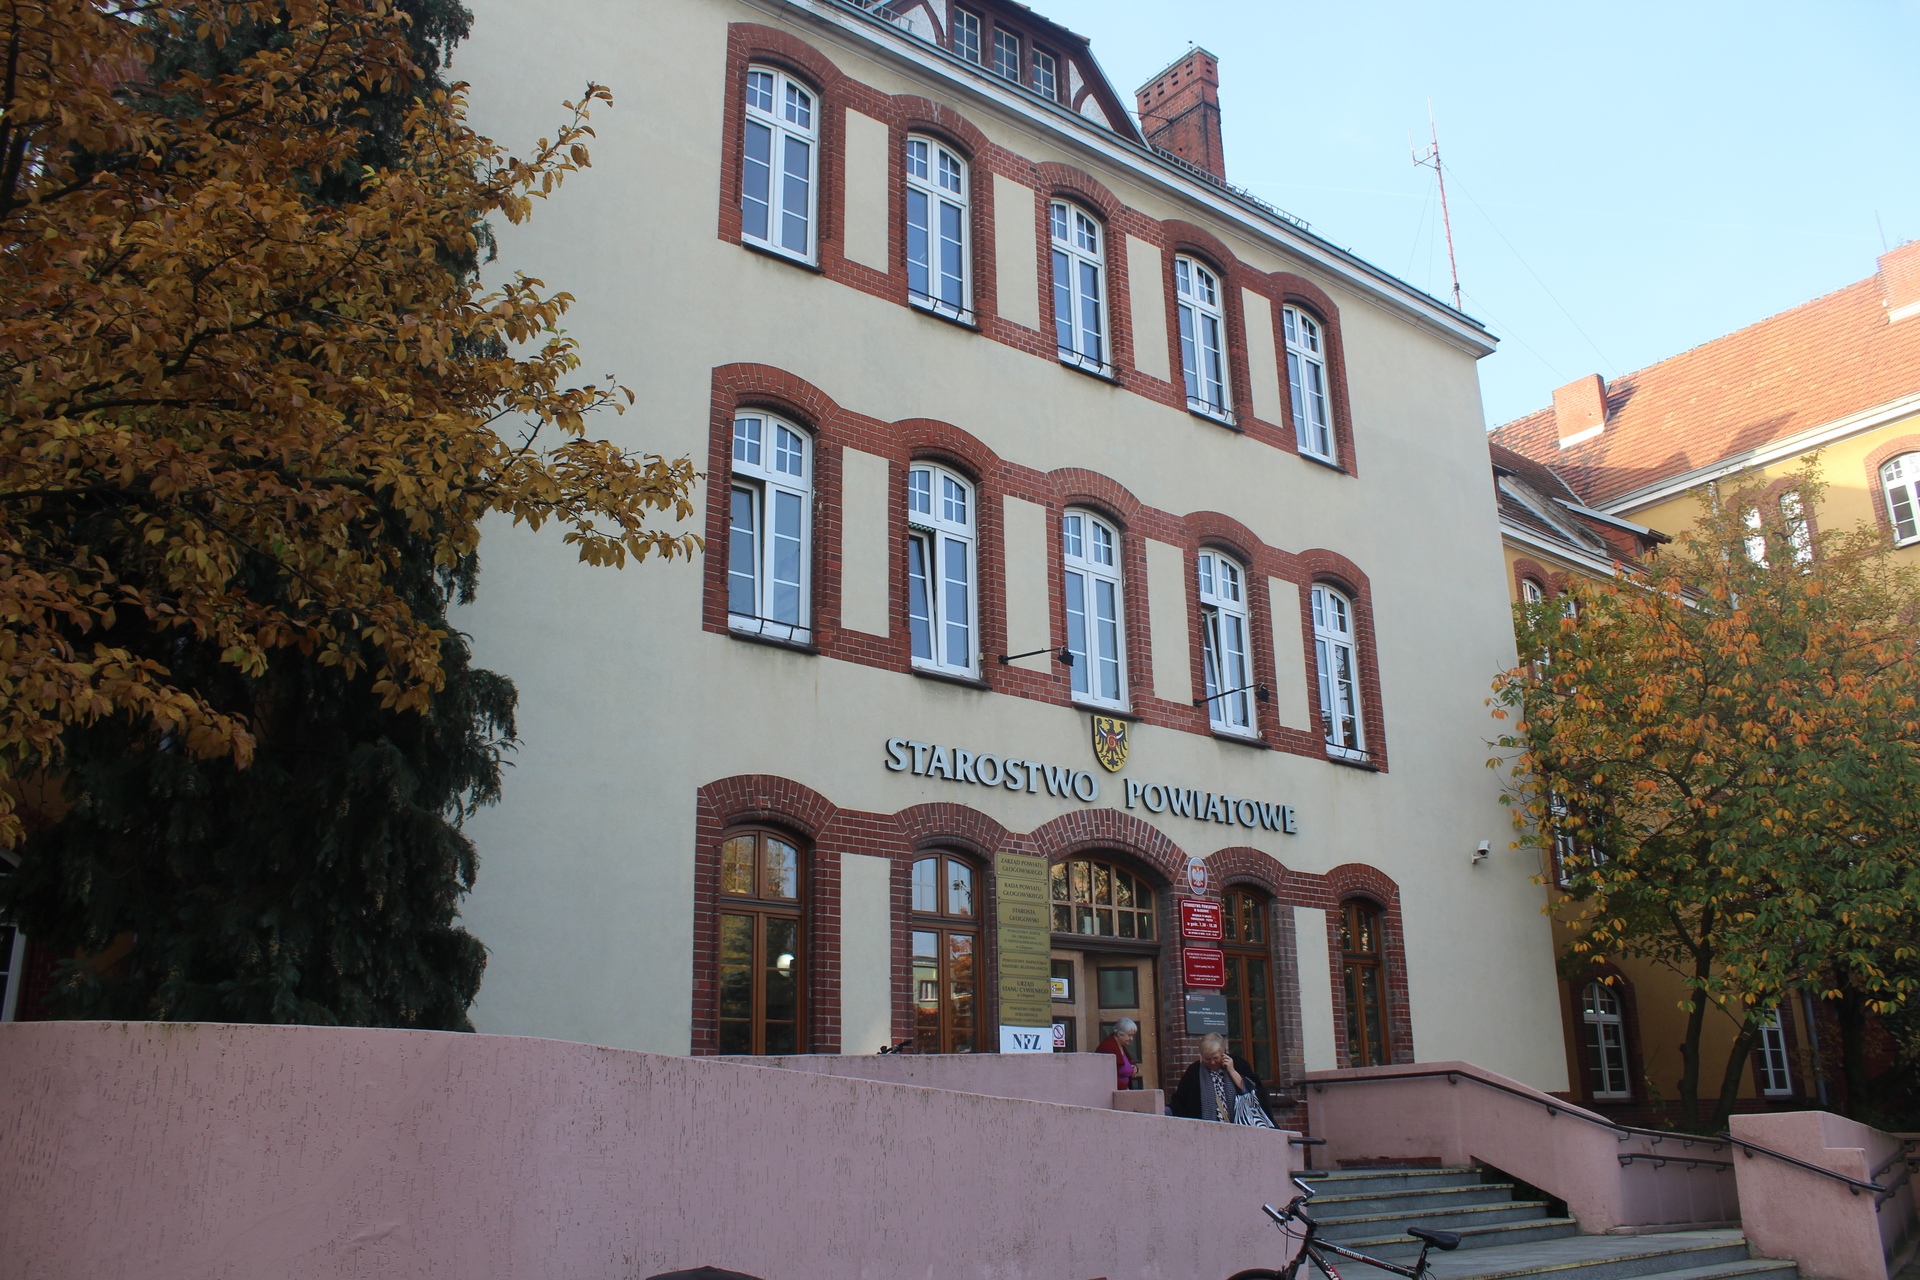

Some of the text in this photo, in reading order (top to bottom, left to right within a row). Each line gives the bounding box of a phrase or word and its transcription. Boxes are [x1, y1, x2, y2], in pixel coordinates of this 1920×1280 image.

[885, 737, 1298, 834] STAROSTWO POWIATOWE
[1000, 858, 1044, 869] ZARZĄD POWIATU
[1002, 865, 1043, 876] GŁOGOWSKIEGO
[1019, 884, 1041, 892] POWIATU
[1002, 890, 1044, 900] GŁOGOWSKIEGO
[1009, 915, 1040, 924] GŁOGOWSKI
[1001, 985, 1019, 993] STANU
[1019, 986, 1049, 995] CYWILNEGO
[1012, 1033, 1042, 1050] NFZ
